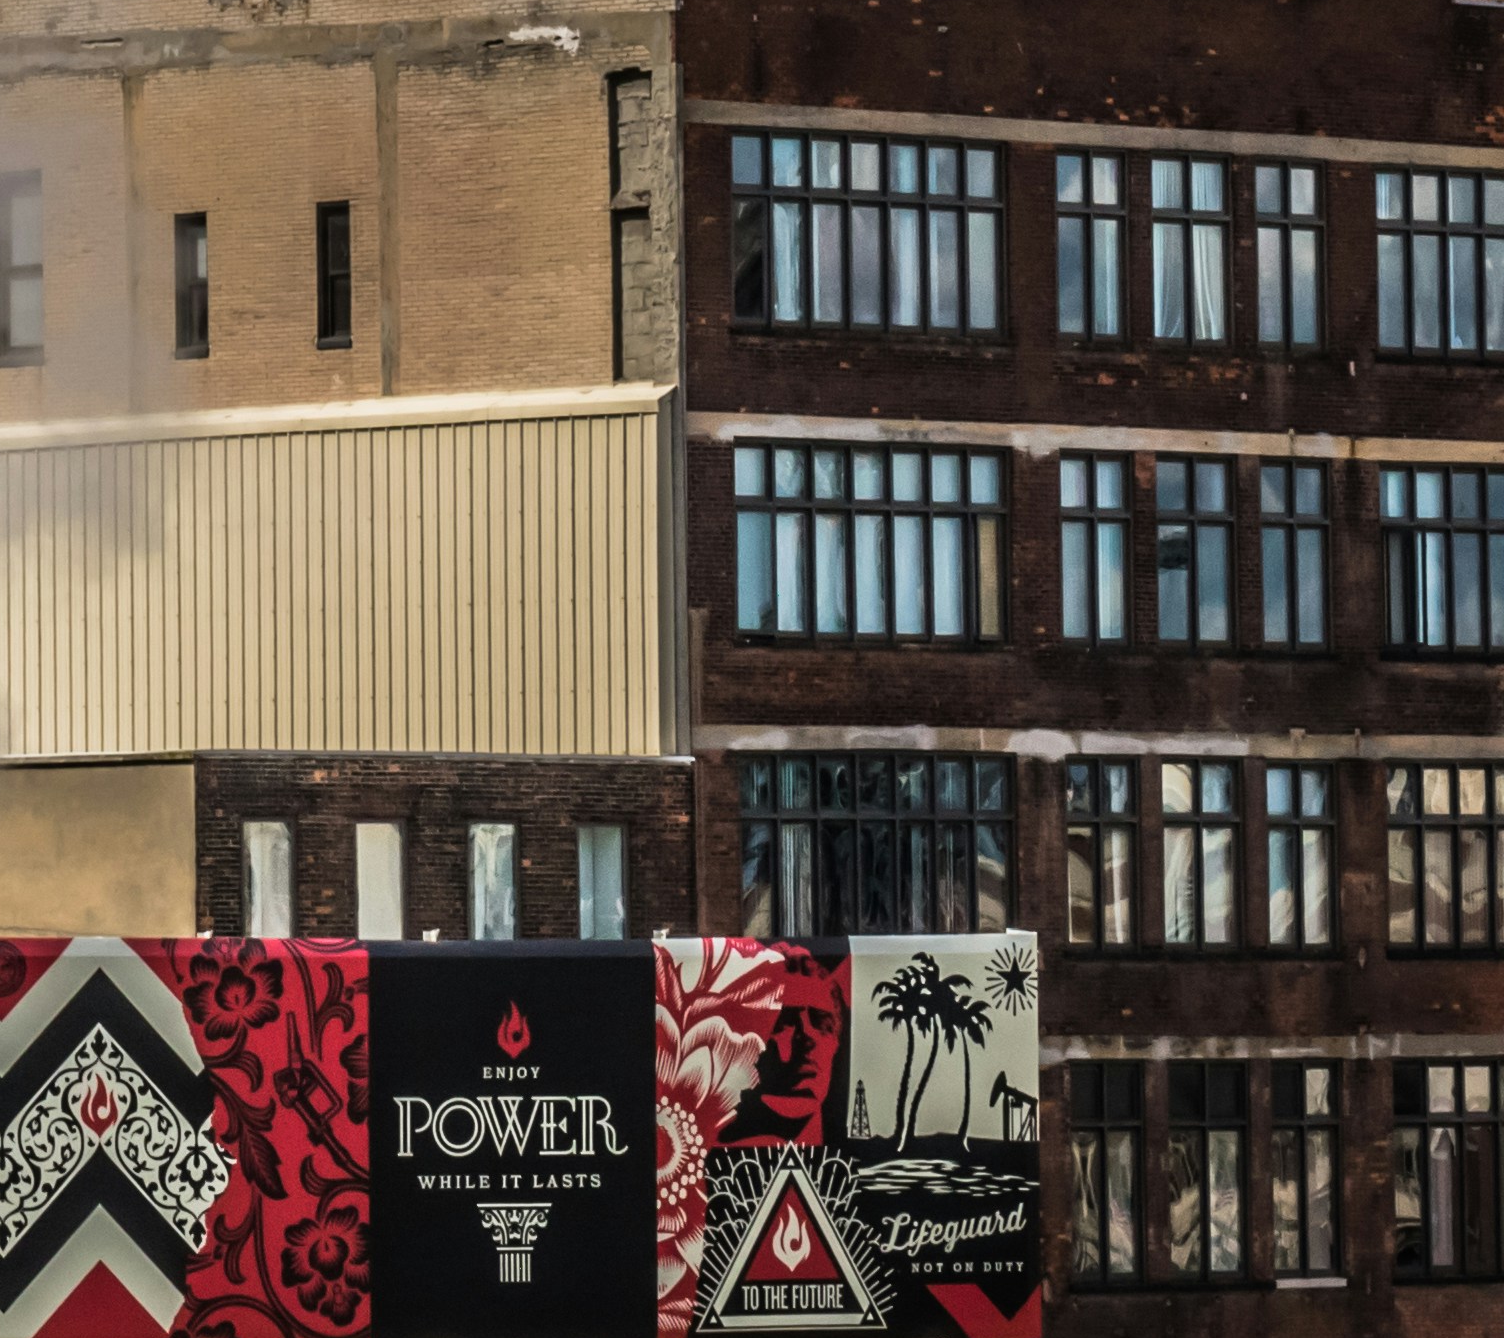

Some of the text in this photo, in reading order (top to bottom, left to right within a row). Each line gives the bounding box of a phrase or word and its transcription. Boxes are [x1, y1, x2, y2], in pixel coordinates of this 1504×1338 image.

[482, 1066, 541, 1081] ENJOY
[393, 1095, 629, 1157] POWER
[417, 1173, 602, 1189] WHILE IT LASTS
[881, 1202, 1027, 1257] Lifeguard
[911, 1261, 1024, 1274] NOT ON DUTY
[742, 1283, 844, 1310] TO THE FUTURE
